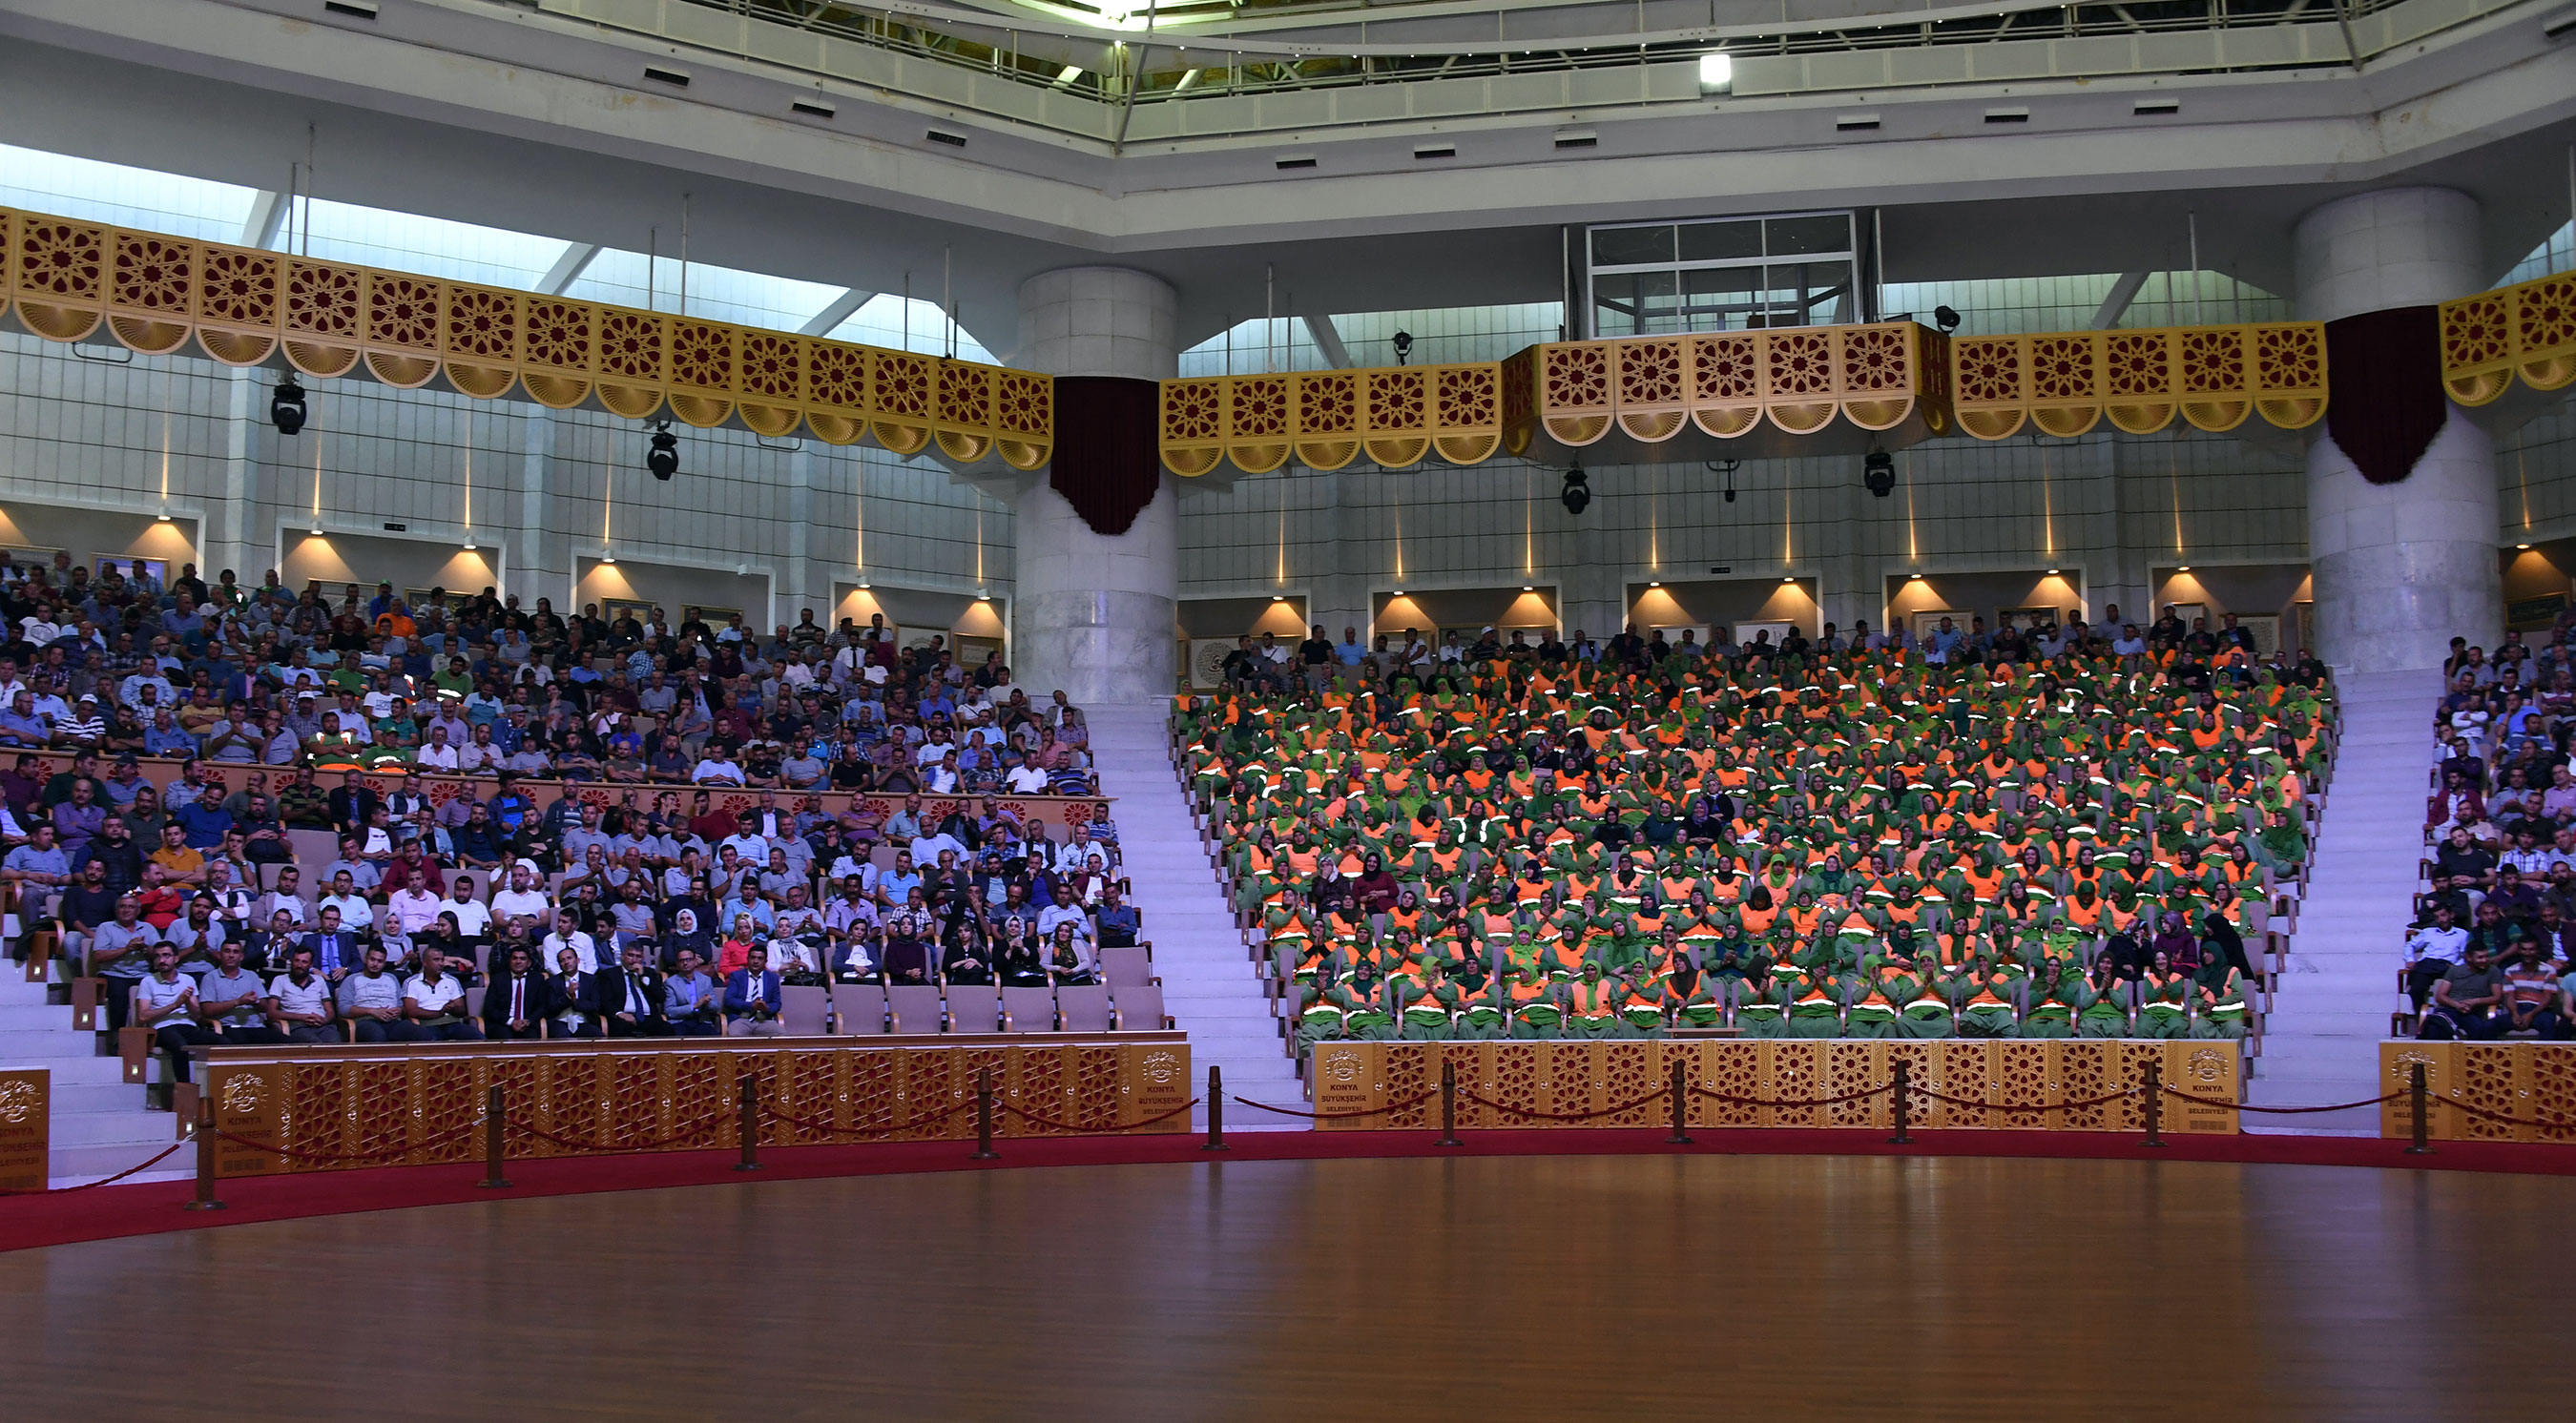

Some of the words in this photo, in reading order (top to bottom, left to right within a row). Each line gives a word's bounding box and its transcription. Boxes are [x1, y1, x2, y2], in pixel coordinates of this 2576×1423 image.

[2192, 1084, 2225, 1093] KONYA
[1321, 1094, 1367, 1103] BÜYÜKŞEHİR
[227, 1117, 262, 1125] KONYA
